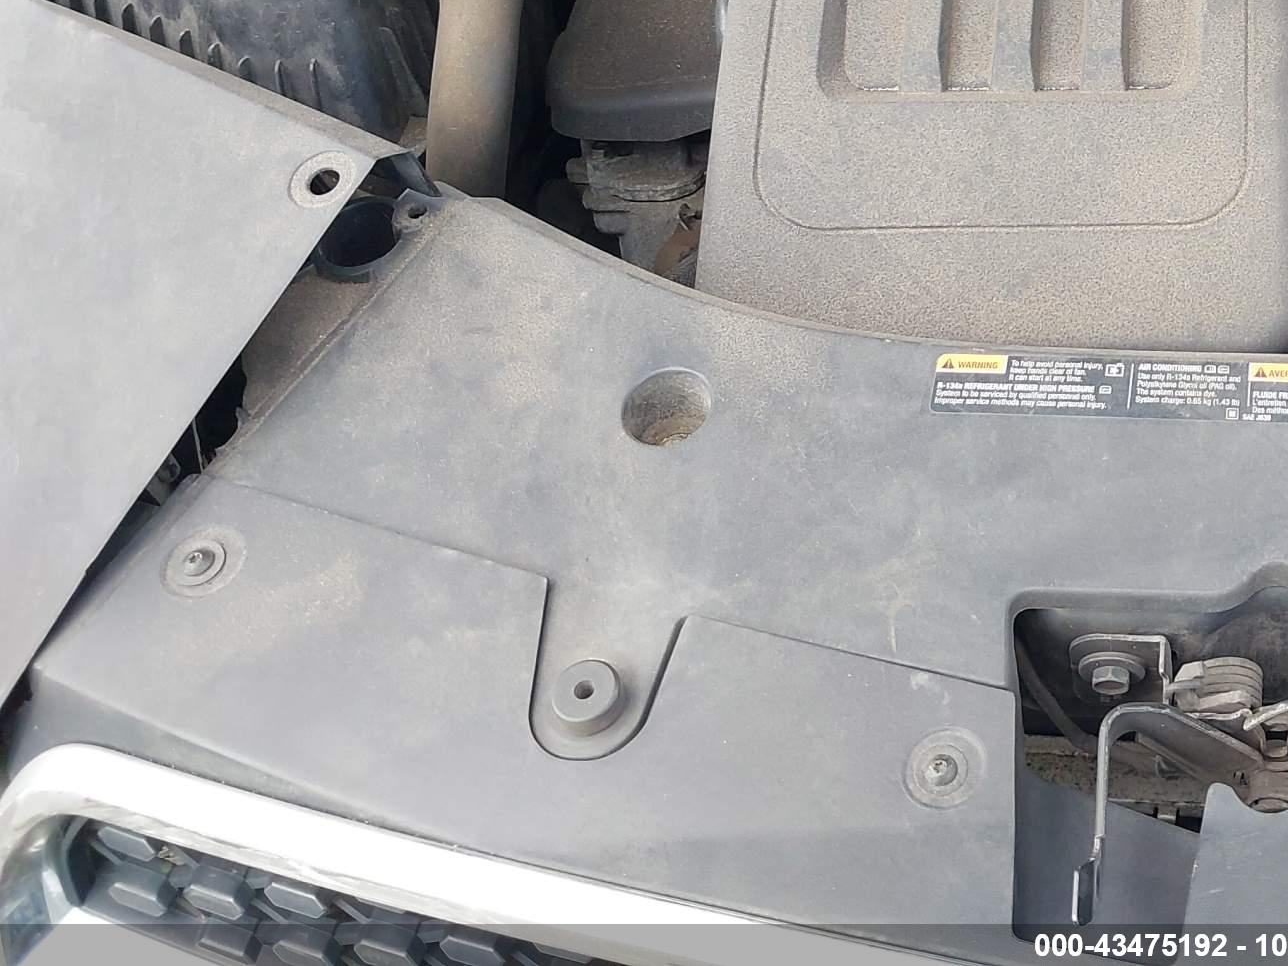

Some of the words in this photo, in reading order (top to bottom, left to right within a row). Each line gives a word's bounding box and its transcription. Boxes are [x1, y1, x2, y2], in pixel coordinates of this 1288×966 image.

[1021, 360, 1034, 368] help
[1084, 362, 1103, 370] injury,
[1152, 364, 1202, 372] CONDITIONING
[1192, 374, 1227, 382] Refrigerant
[964, 382, 1013, 390] REFRIGERANT
[1040, 384, 1057, 392] HIGH
[936, 389, 961, 397] System
[1019, 392, 1047, 400] qualified
[1204, 390, 1217, 398] dye.
[1253, 391, 1278, 399] FLUIDE
[1161, 396, 1185, 405] charge:
[1203, 398, 1211, 406] kg
[1212, 398, 1230, 406] (1.43
[1252, 398, 1286, 406] L'entretien
[1252, 406, 1265, 414] Des
